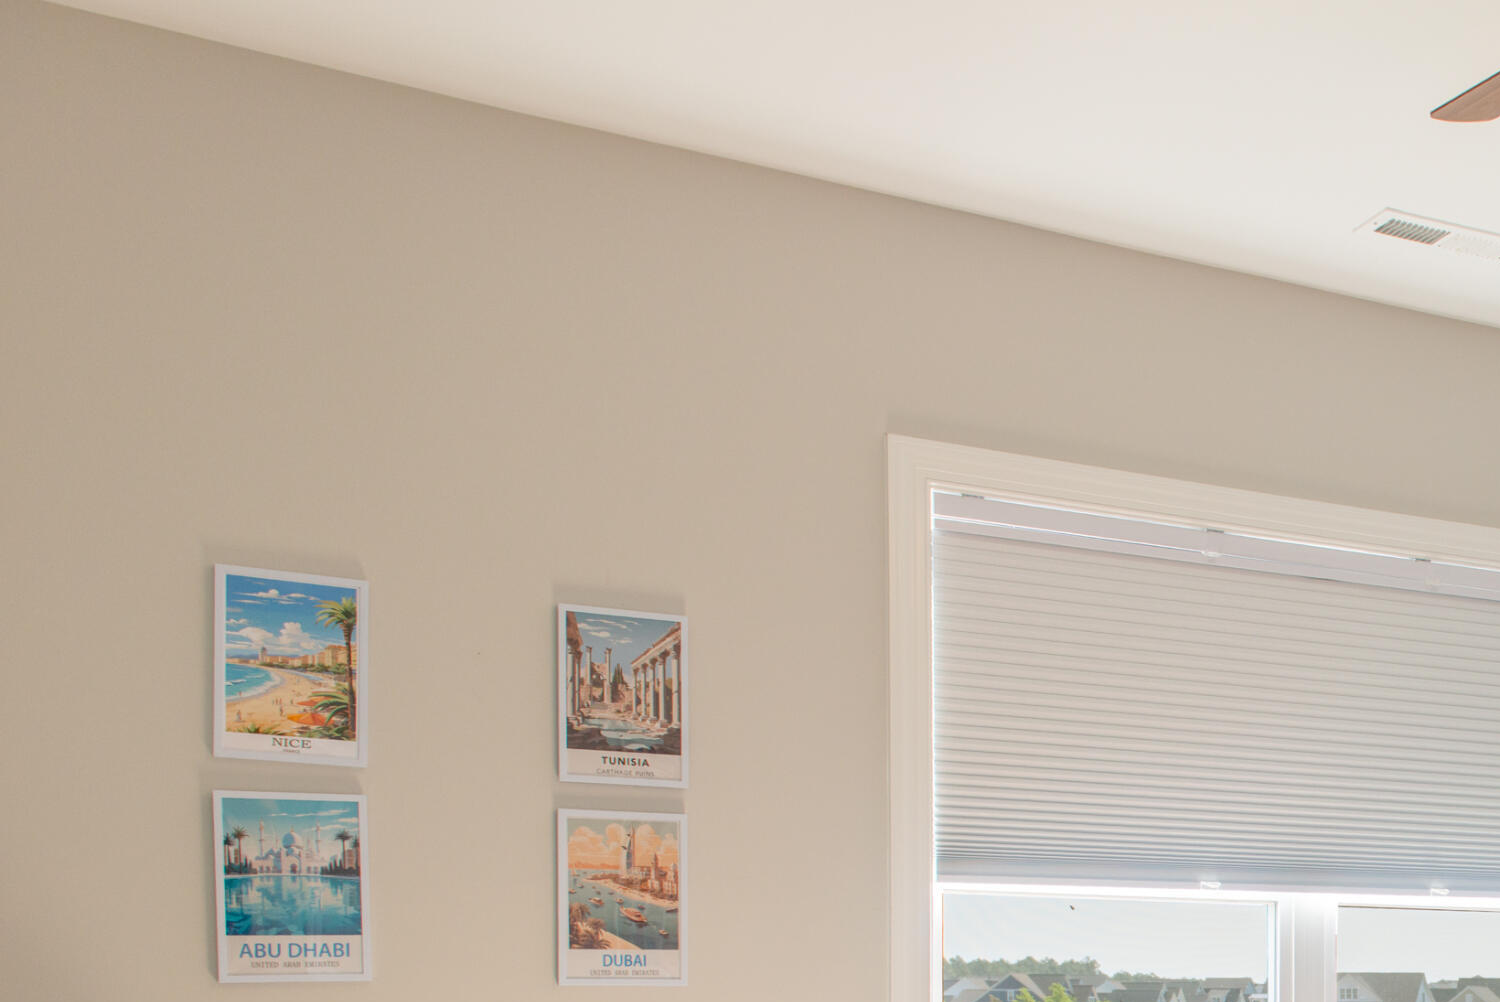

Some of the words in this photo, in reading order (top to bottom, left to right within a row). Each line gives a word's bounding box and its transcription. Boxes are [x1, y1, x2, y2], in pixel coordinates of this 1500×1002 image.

[271, 737, 312, 749] NICE
[601, 756, 650, 767] TUNISIA
[239, 943, 281, 958] ABU
[288, 942, 351, 958] DHABI
[602, 953, 647, 967] DUBAI
